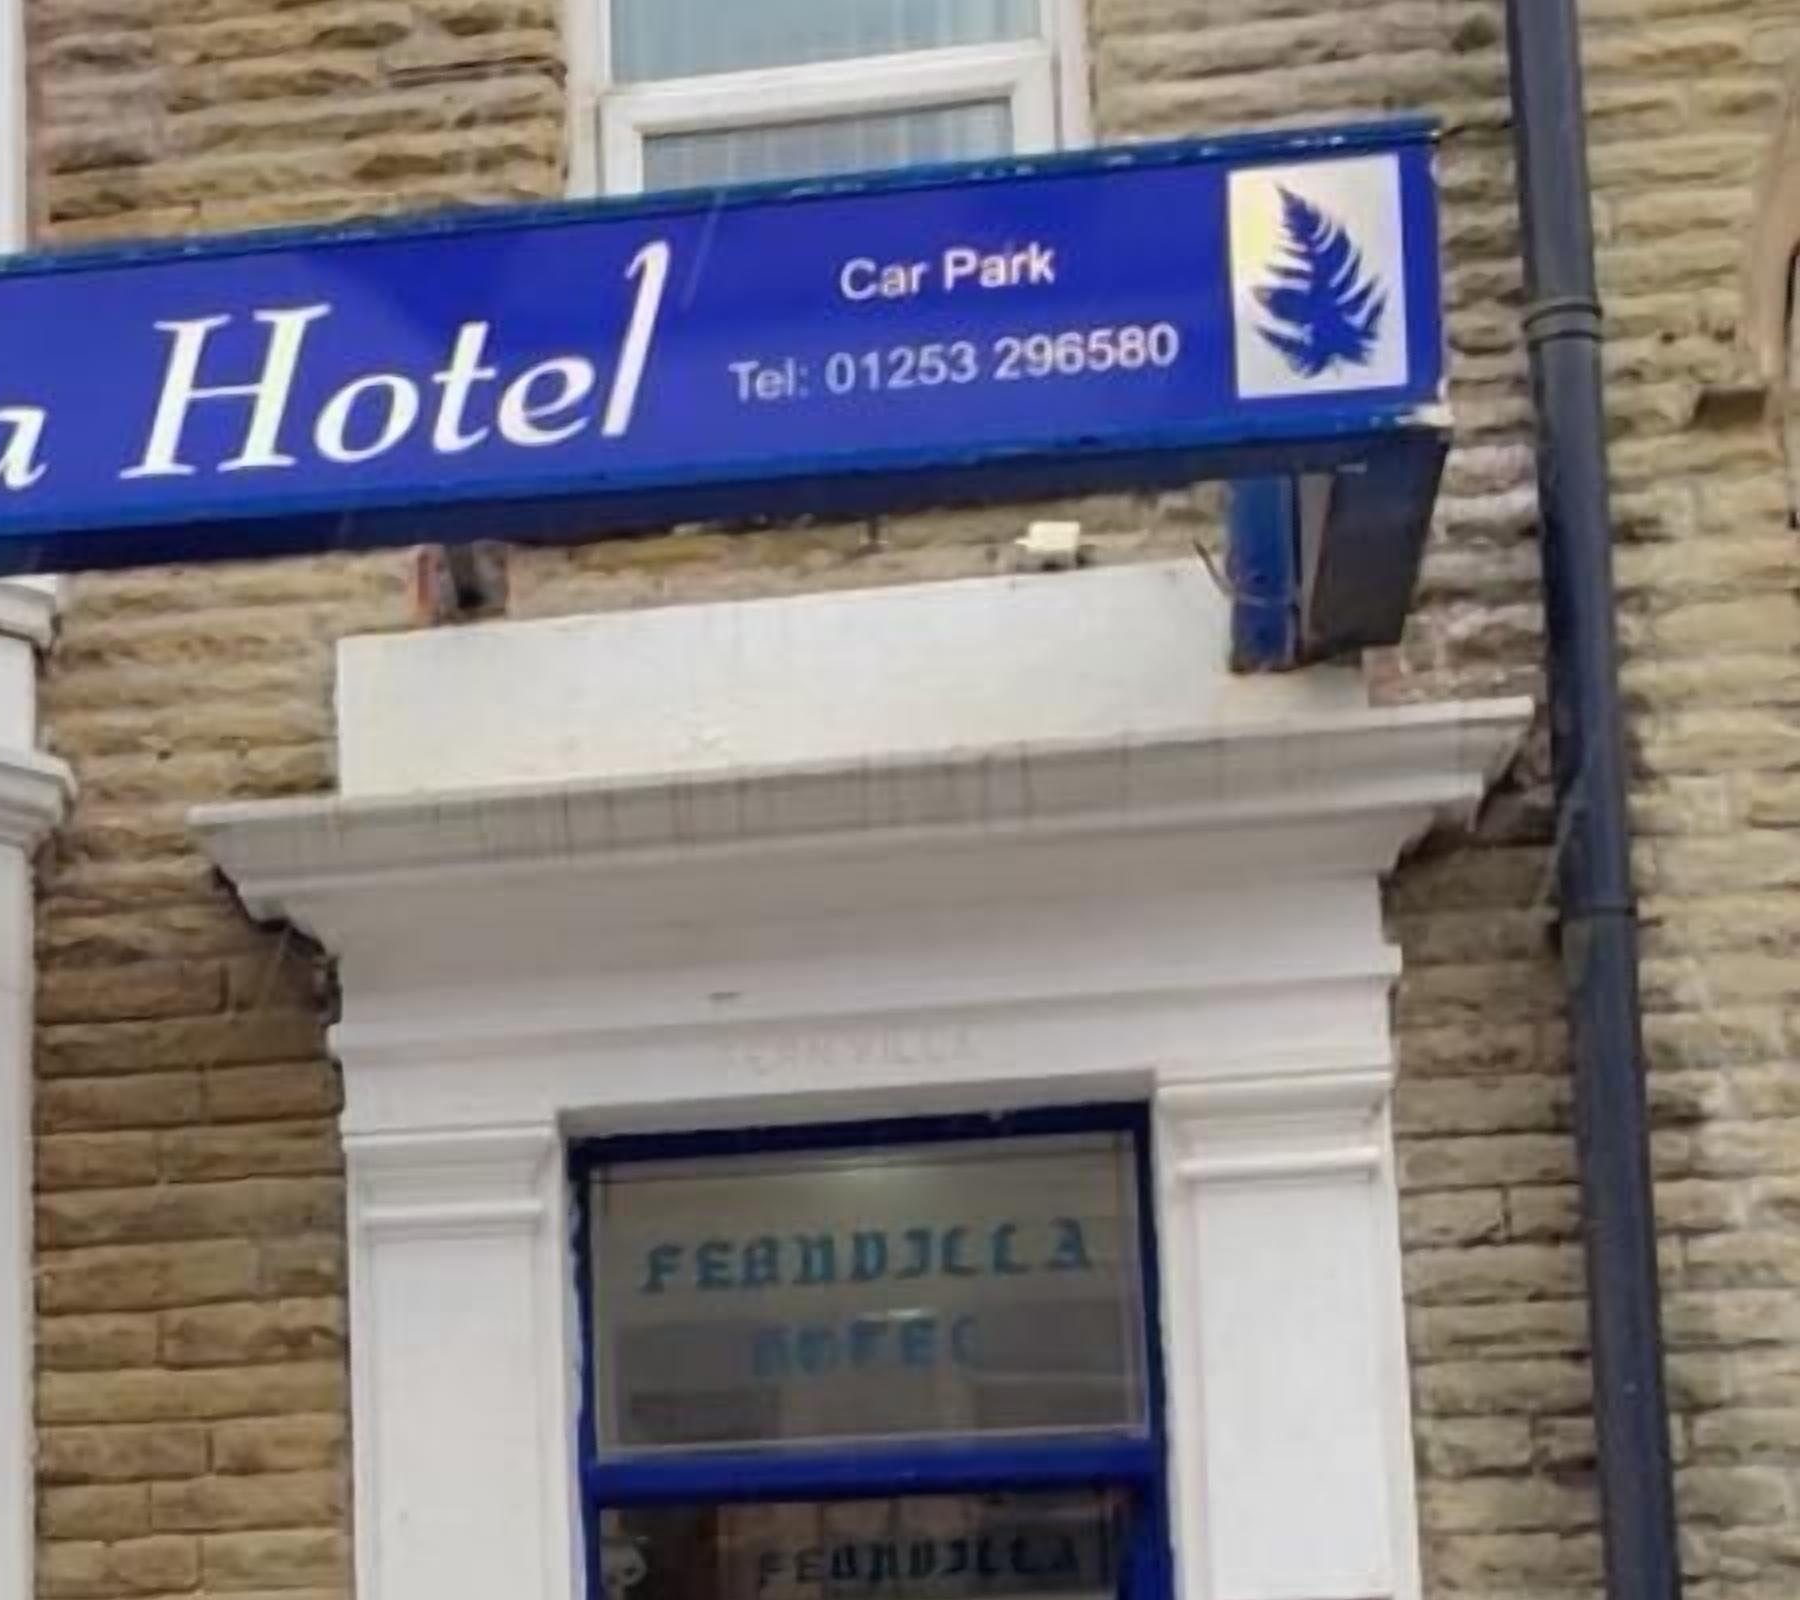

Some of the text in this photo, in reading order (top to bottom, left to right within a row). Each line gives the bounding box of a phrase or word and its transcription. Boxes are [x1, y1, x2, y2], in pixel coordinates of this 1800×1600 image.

[840, 241, 1056, 301] Car Park
[118, 240, 671, 480] Hotel
[730, 321, 1180, 403] Tel: 01253 296580
